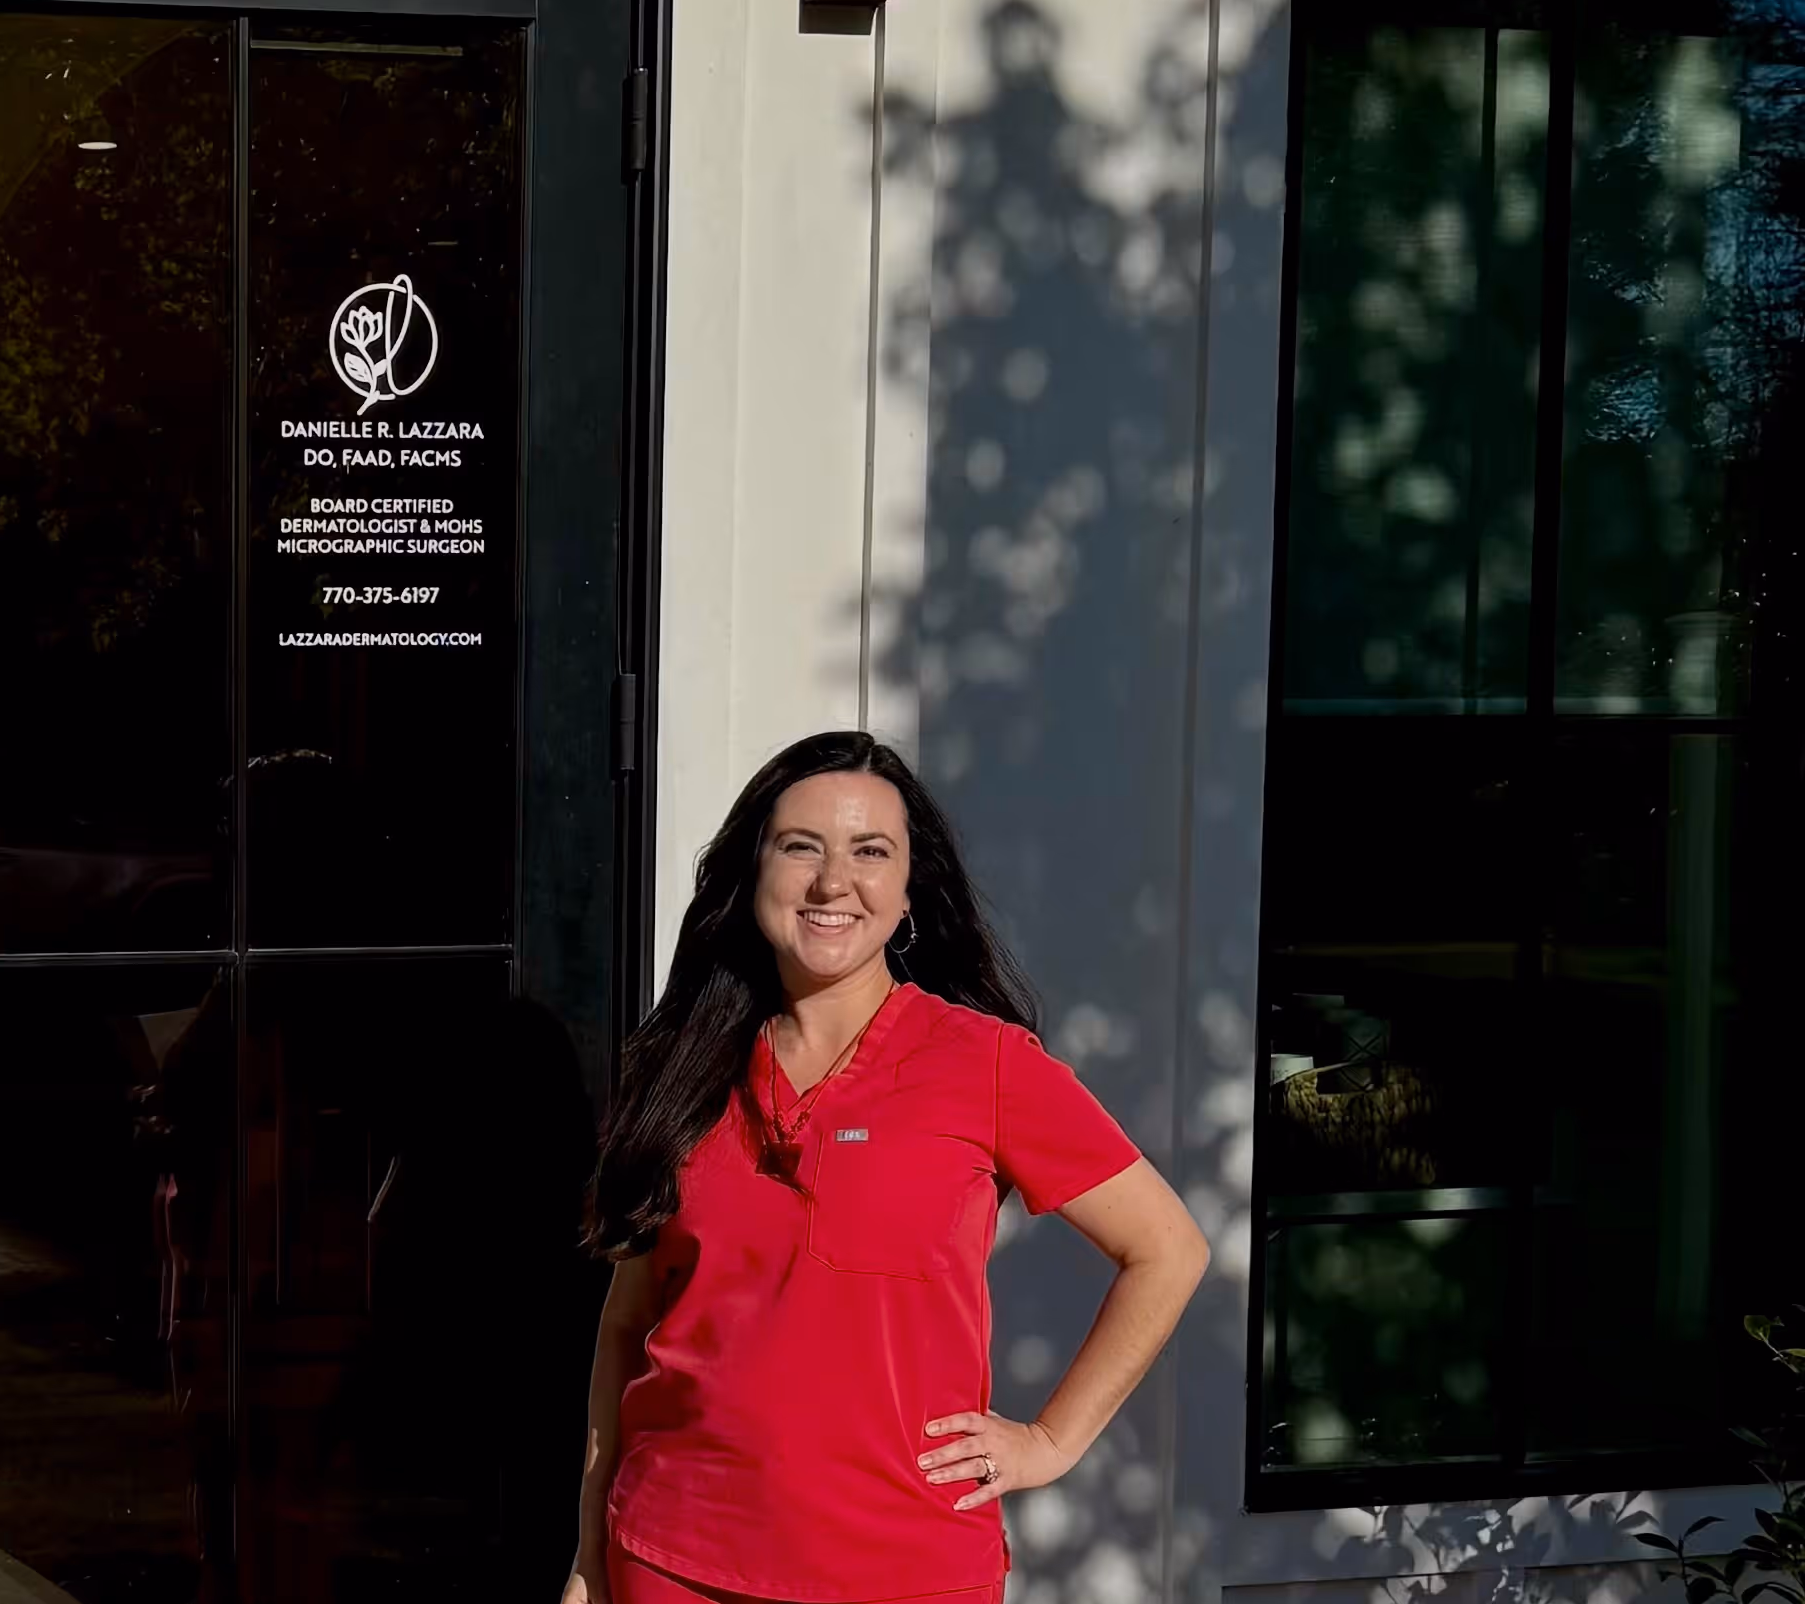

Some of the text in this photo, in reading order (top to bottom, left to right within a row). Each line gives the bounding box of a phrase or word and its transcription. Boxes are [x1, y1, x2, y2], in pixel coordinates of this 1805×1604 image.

[281, 421, 484, 439] DANIELLE R. LAZZARA
[304, 449, 462, 469] DO, FAAD, FACMS
[311, 498, 454, 513] BOARD CERTIFIED
[280, 518, 483, 534] DERMATOLOGIST & MOHS
[277, 539, 485, 554] MICROGRAPHIC SURGEON
[322, 587, 440, 604] 770-375-6197
[279, 632, 482, 646] LAZZARADERMATOLOGY.COM
